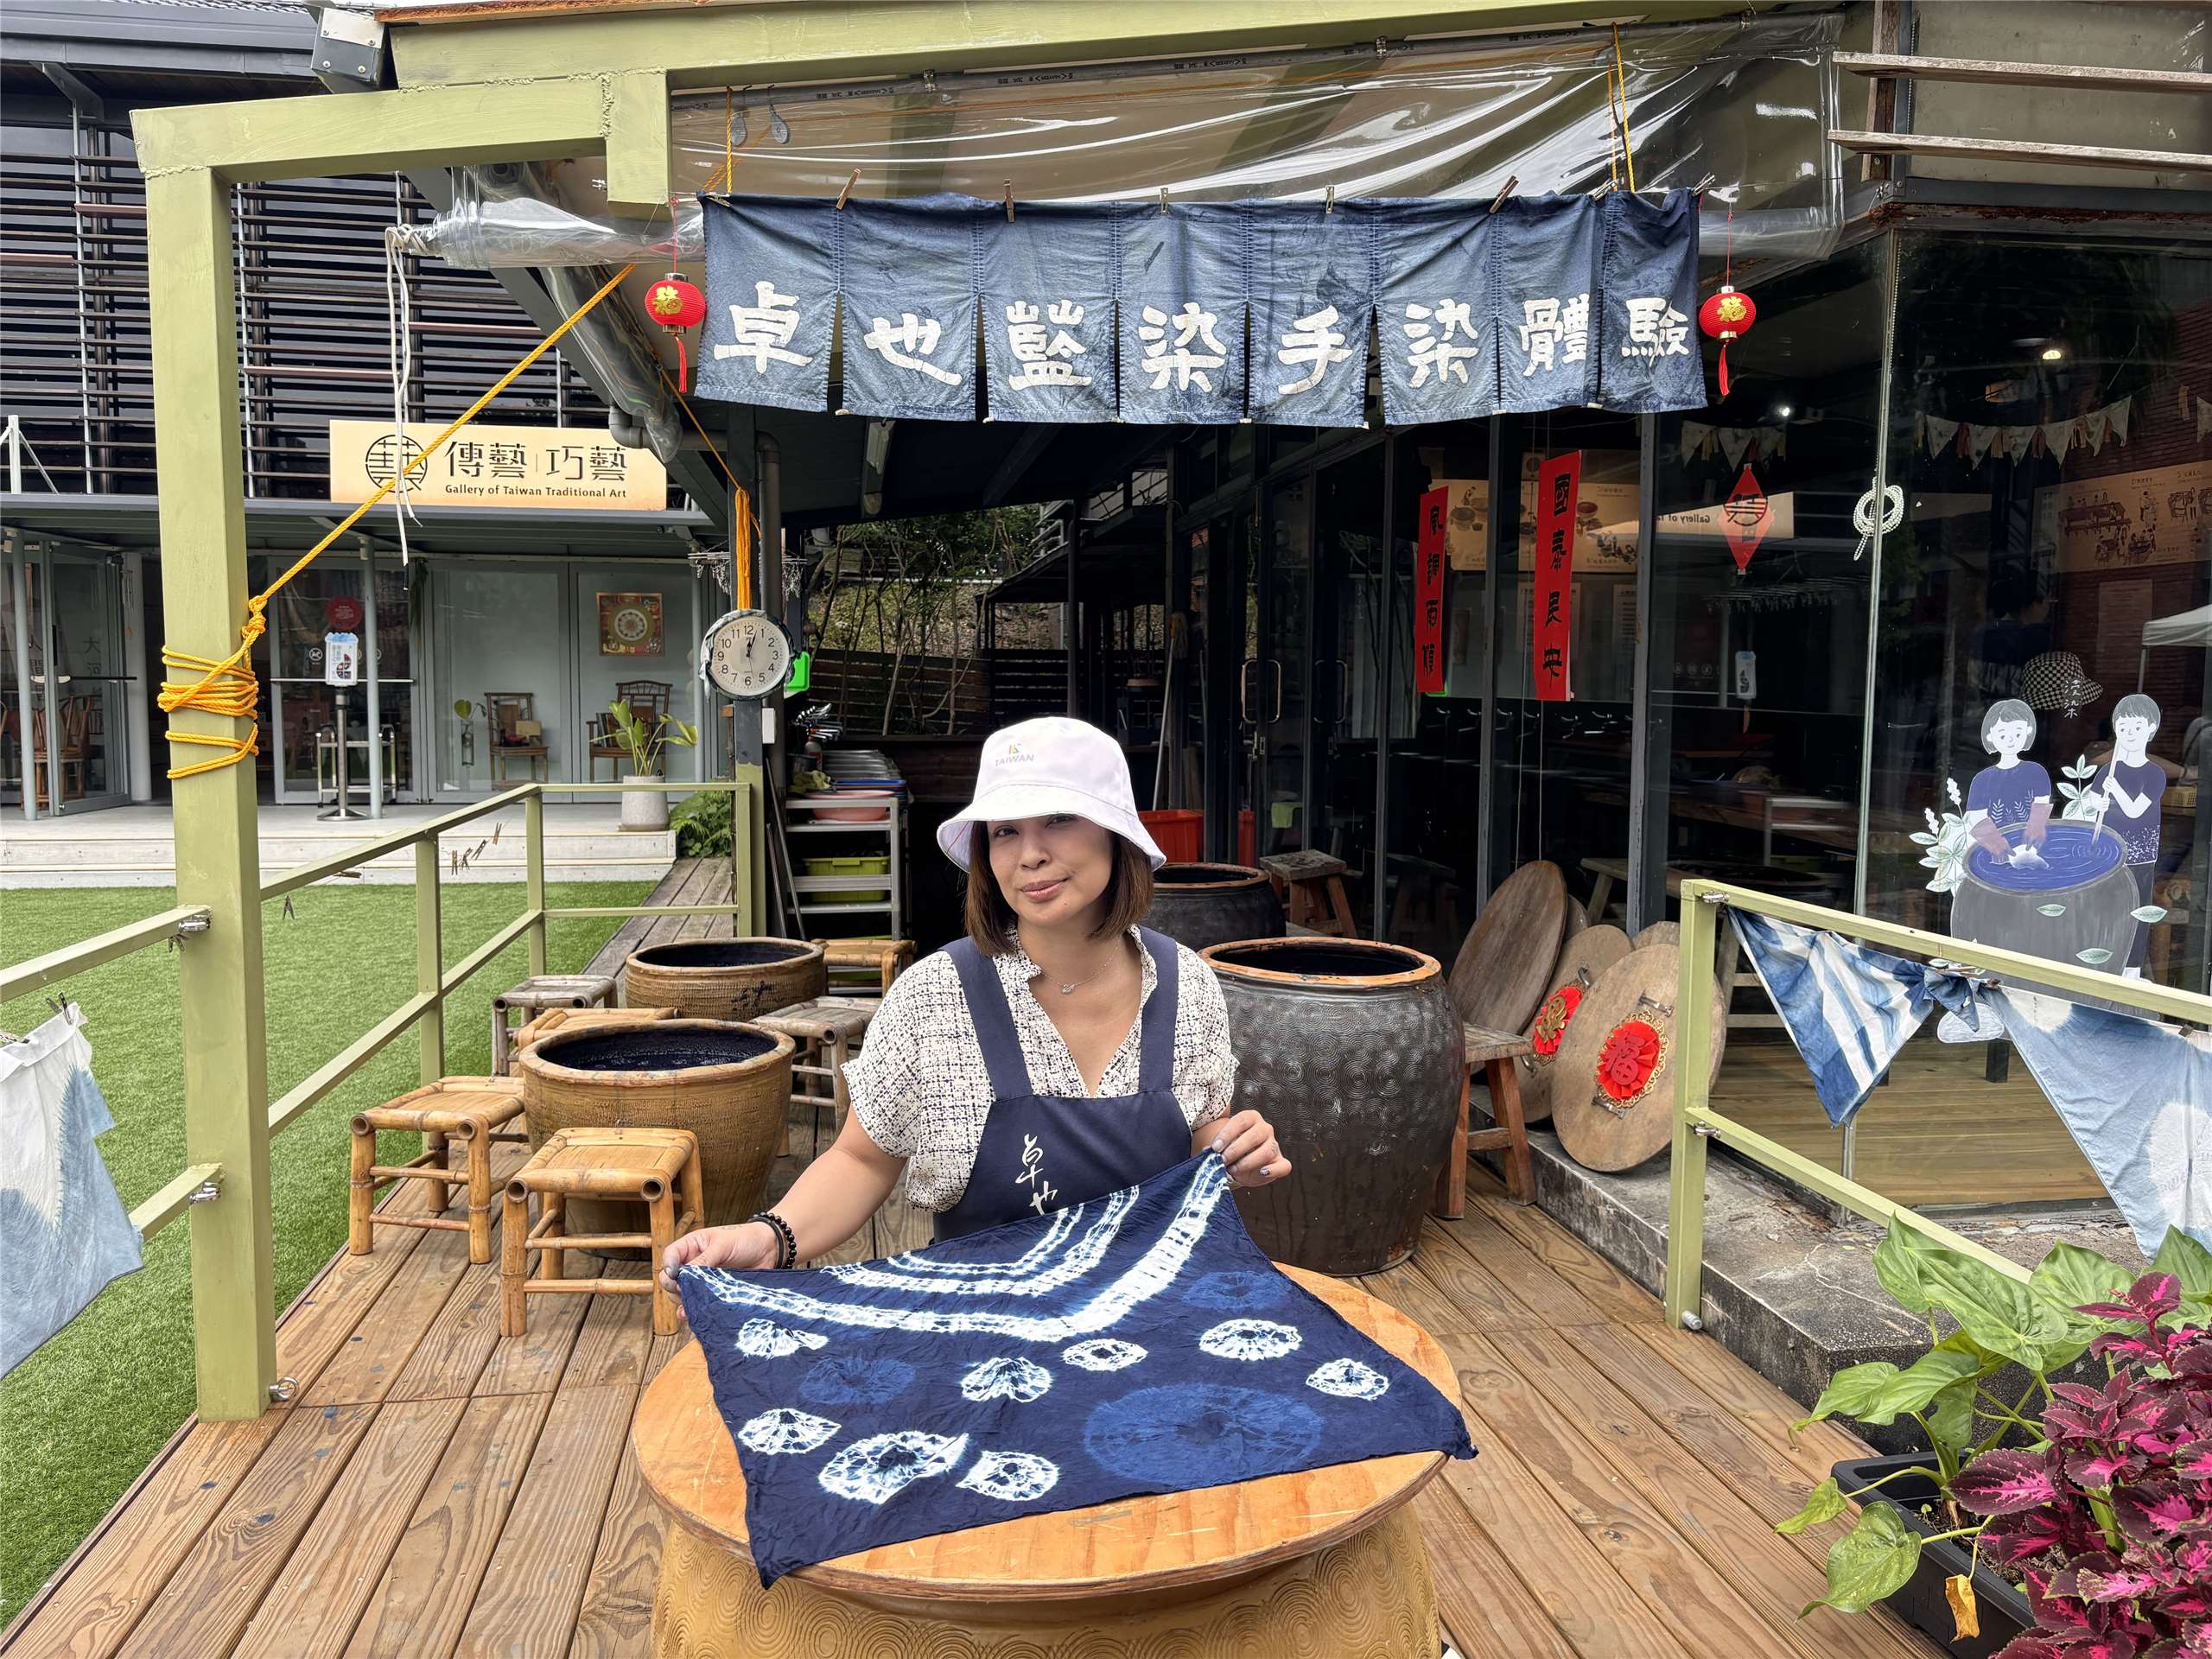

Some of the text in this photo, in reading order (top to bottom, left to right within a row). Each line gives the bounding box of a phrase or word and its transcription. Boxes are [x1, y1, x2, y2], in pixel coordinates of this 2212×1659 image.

[444, 441, 627, 482] 傳藝 巧藝
[445, 484, 627, 499] Gallery of Taiwan Traditional Art
[732, 629, 740, 639] 11
[744, 625, 753, 635] 12
[721, 639, 732, 649] 10
[767, 638, 775, 647] 2
[717, 651, 725, 661] 9
[772, 650, 779, 660] 3
[721, 664, 728, 674] 8
[767, 663, 775, 672] 4
[731, 673, 738, 683] 7
[744, 677, 752, 686] 6
[759, 672, 766, 683] 5
[995, 753, 1035, 767] TAIWAN
